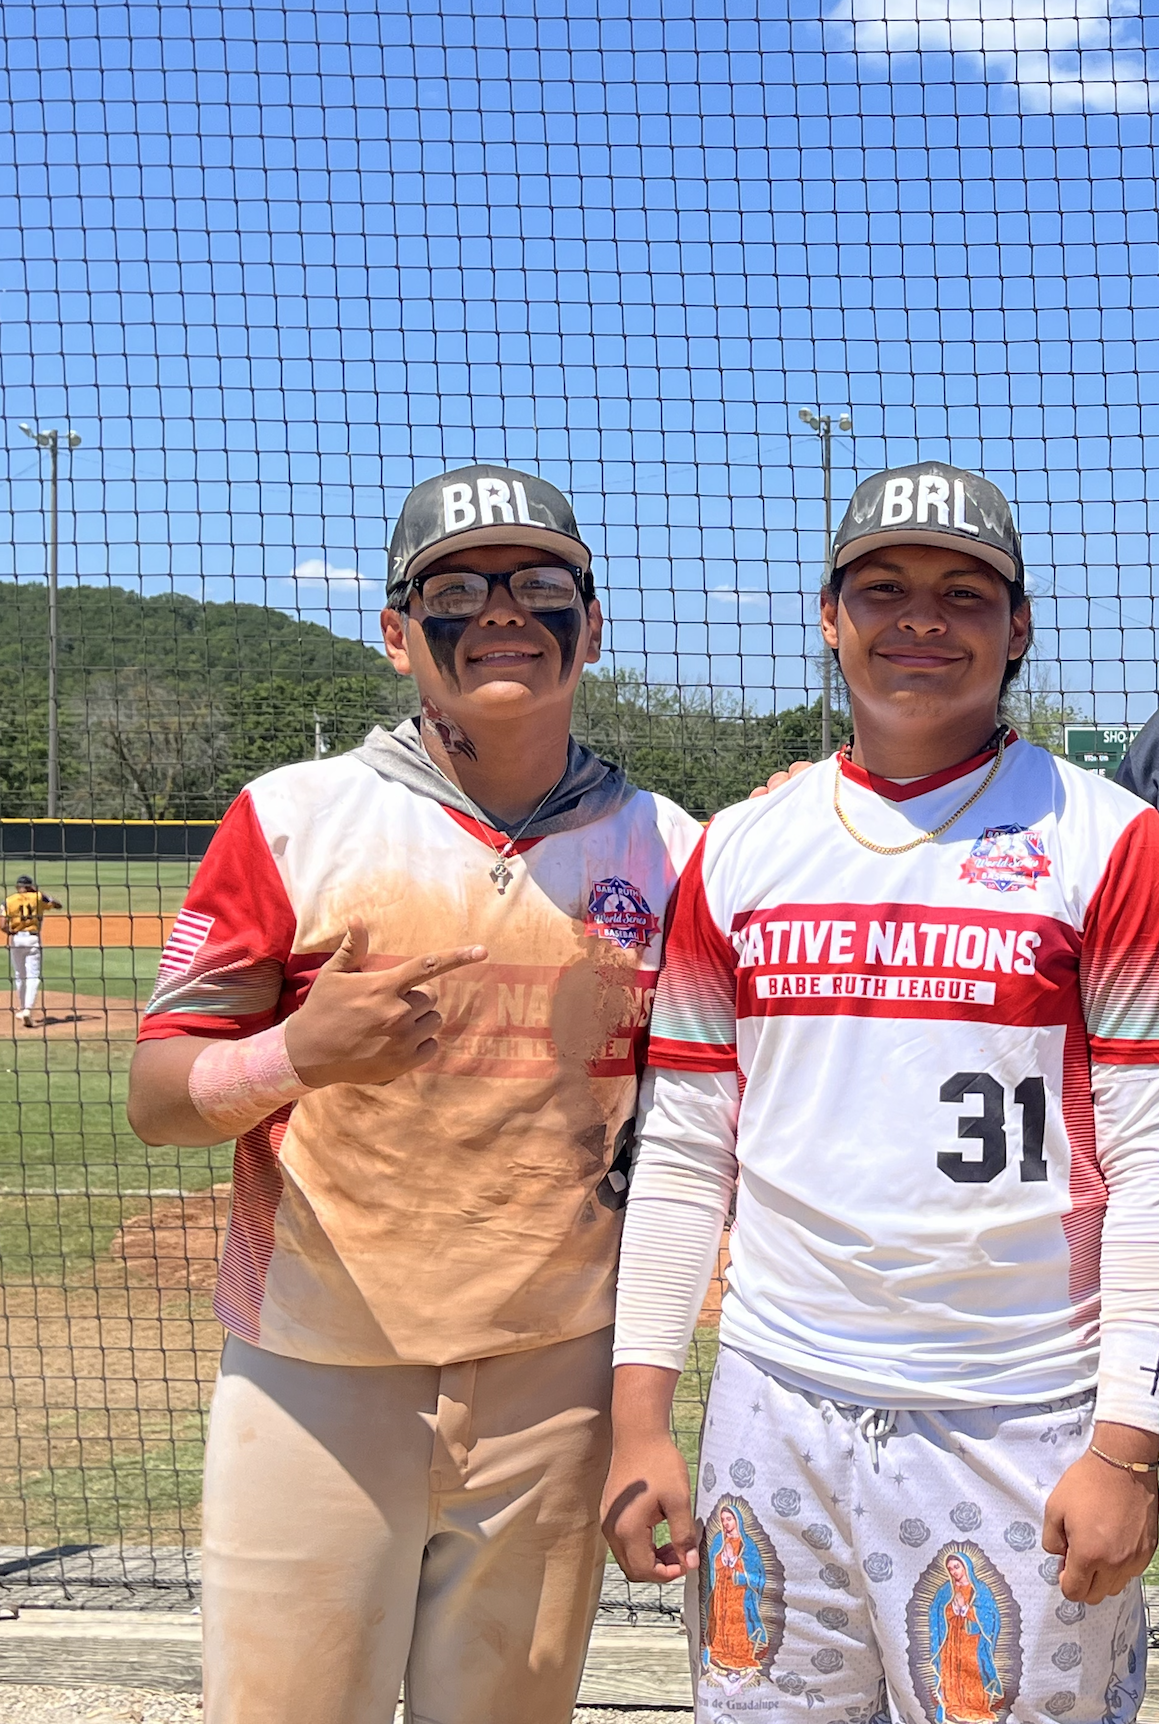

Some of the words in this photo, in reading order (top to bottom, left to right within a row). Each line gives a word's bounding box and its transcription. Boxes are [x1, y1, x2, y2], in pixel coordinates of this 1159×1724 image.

[442, 478, 546, 533] BRL
[881, 475, 979, 535] BRL
[596, 885, 616, 894] BABE
[618, 888, 639, 897] RUTH
[594, 913, 622, 924] World
[623, 913, 647, 925] Series
[865, 921, 1042, 975] NATIONS
[768, 977, 820, 995] BABE
[832, 976, 887, 997] RUTH
[896, 979, 976, 1001] LEAGUE
[936, 1072, 1048, 1183] 31
[712, 1699, 723, 1709] de
[726, 1699, 779, 1711] Guadalupe
